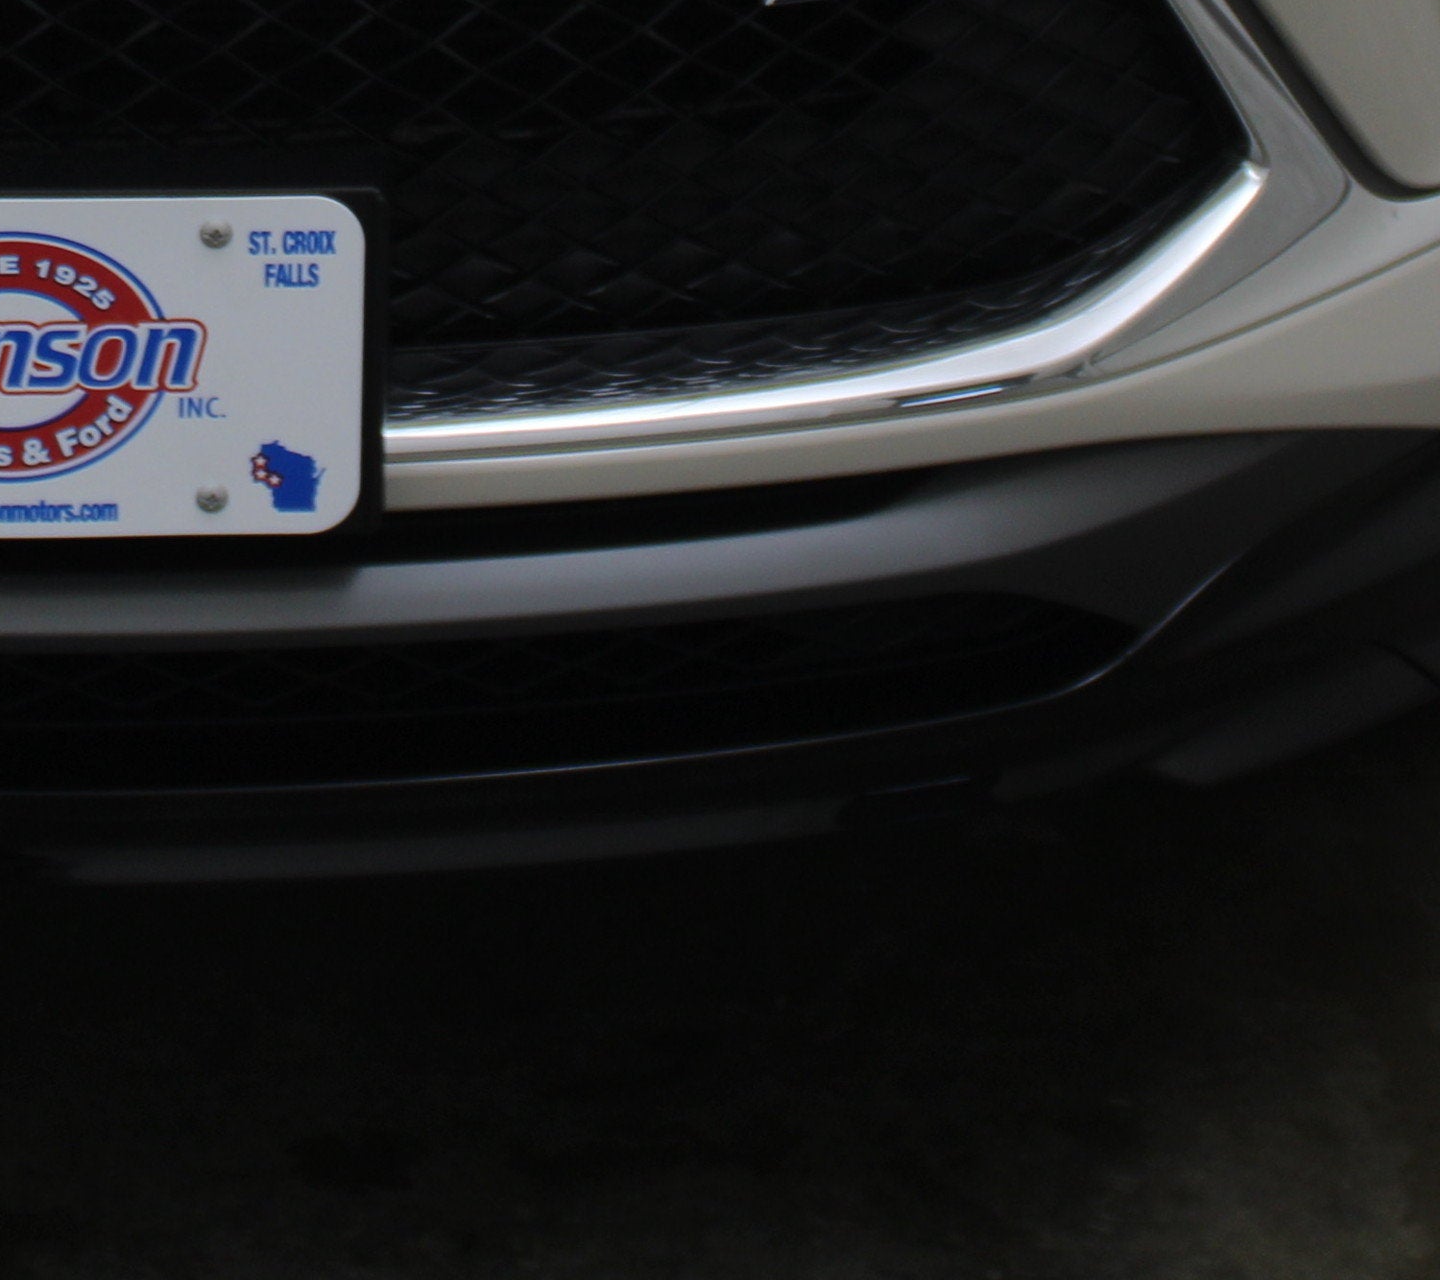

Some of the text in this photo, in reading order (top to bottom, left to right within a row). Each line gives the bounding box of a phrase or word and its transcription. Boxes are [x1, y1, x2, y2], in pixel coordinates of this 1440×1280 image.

[248, 230, 336, 255] ST. CROIX
[35, 258, 116, 312] 1925
[264, 263, 319, 287] FALLS
[178, 396, 226, 419] INC.
[21, 437, 51, 466] &
[55, 393, 134, 458] Ford
